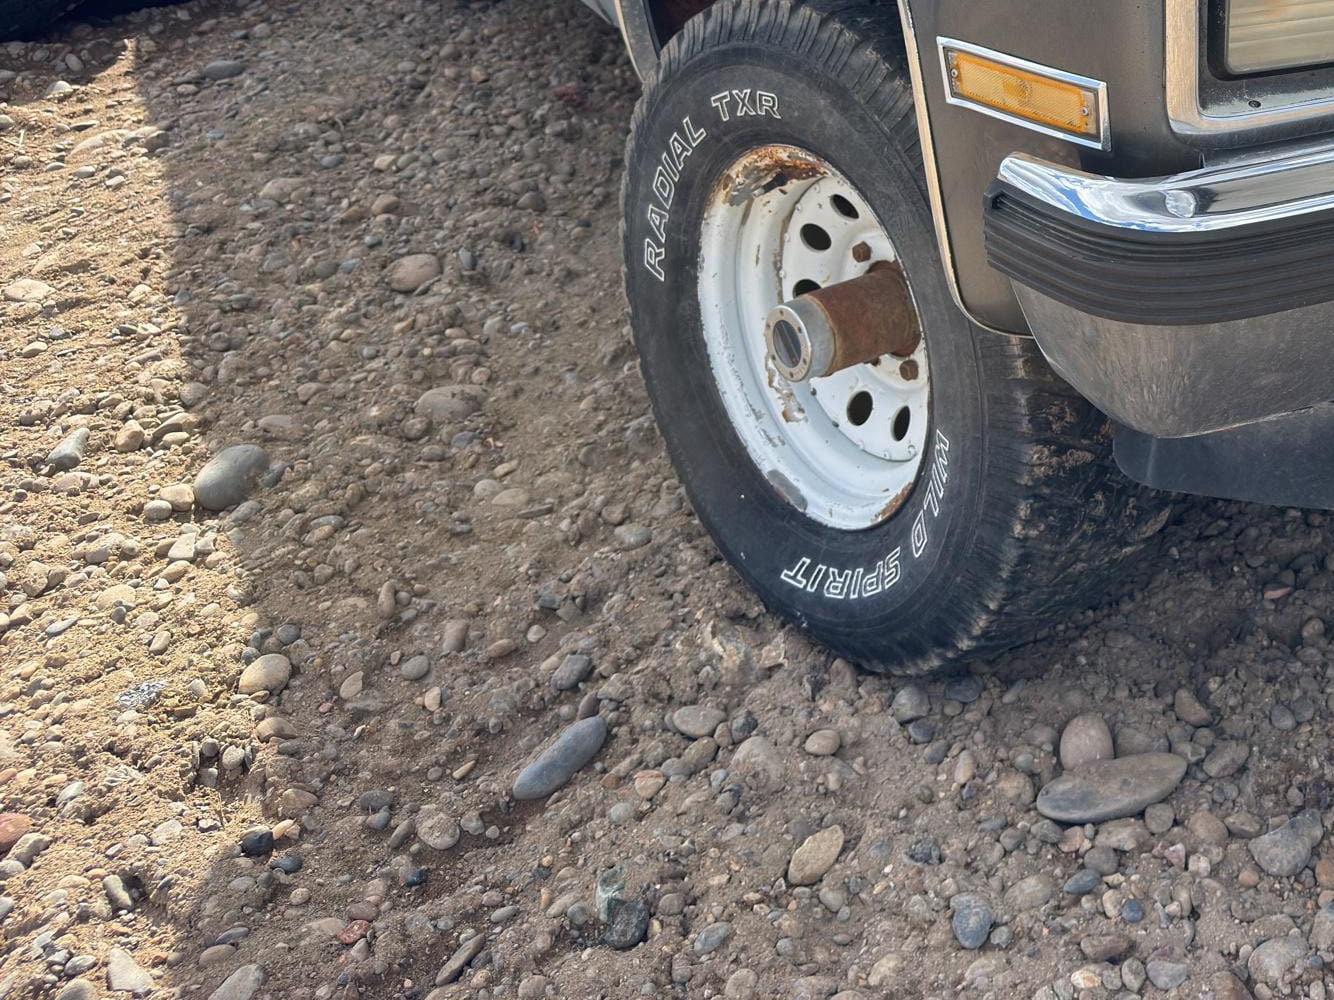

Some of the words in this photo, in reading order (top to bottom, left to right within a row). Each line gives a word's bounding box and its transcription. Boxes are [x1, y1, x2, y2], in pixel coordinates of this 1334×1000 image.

[643, 116, 707, 281] RADIAL
[710, 88, 782, 121] TXR
[912, 429, 950, 558] WILD
[780, 545, 901, 599] SPIRIT
